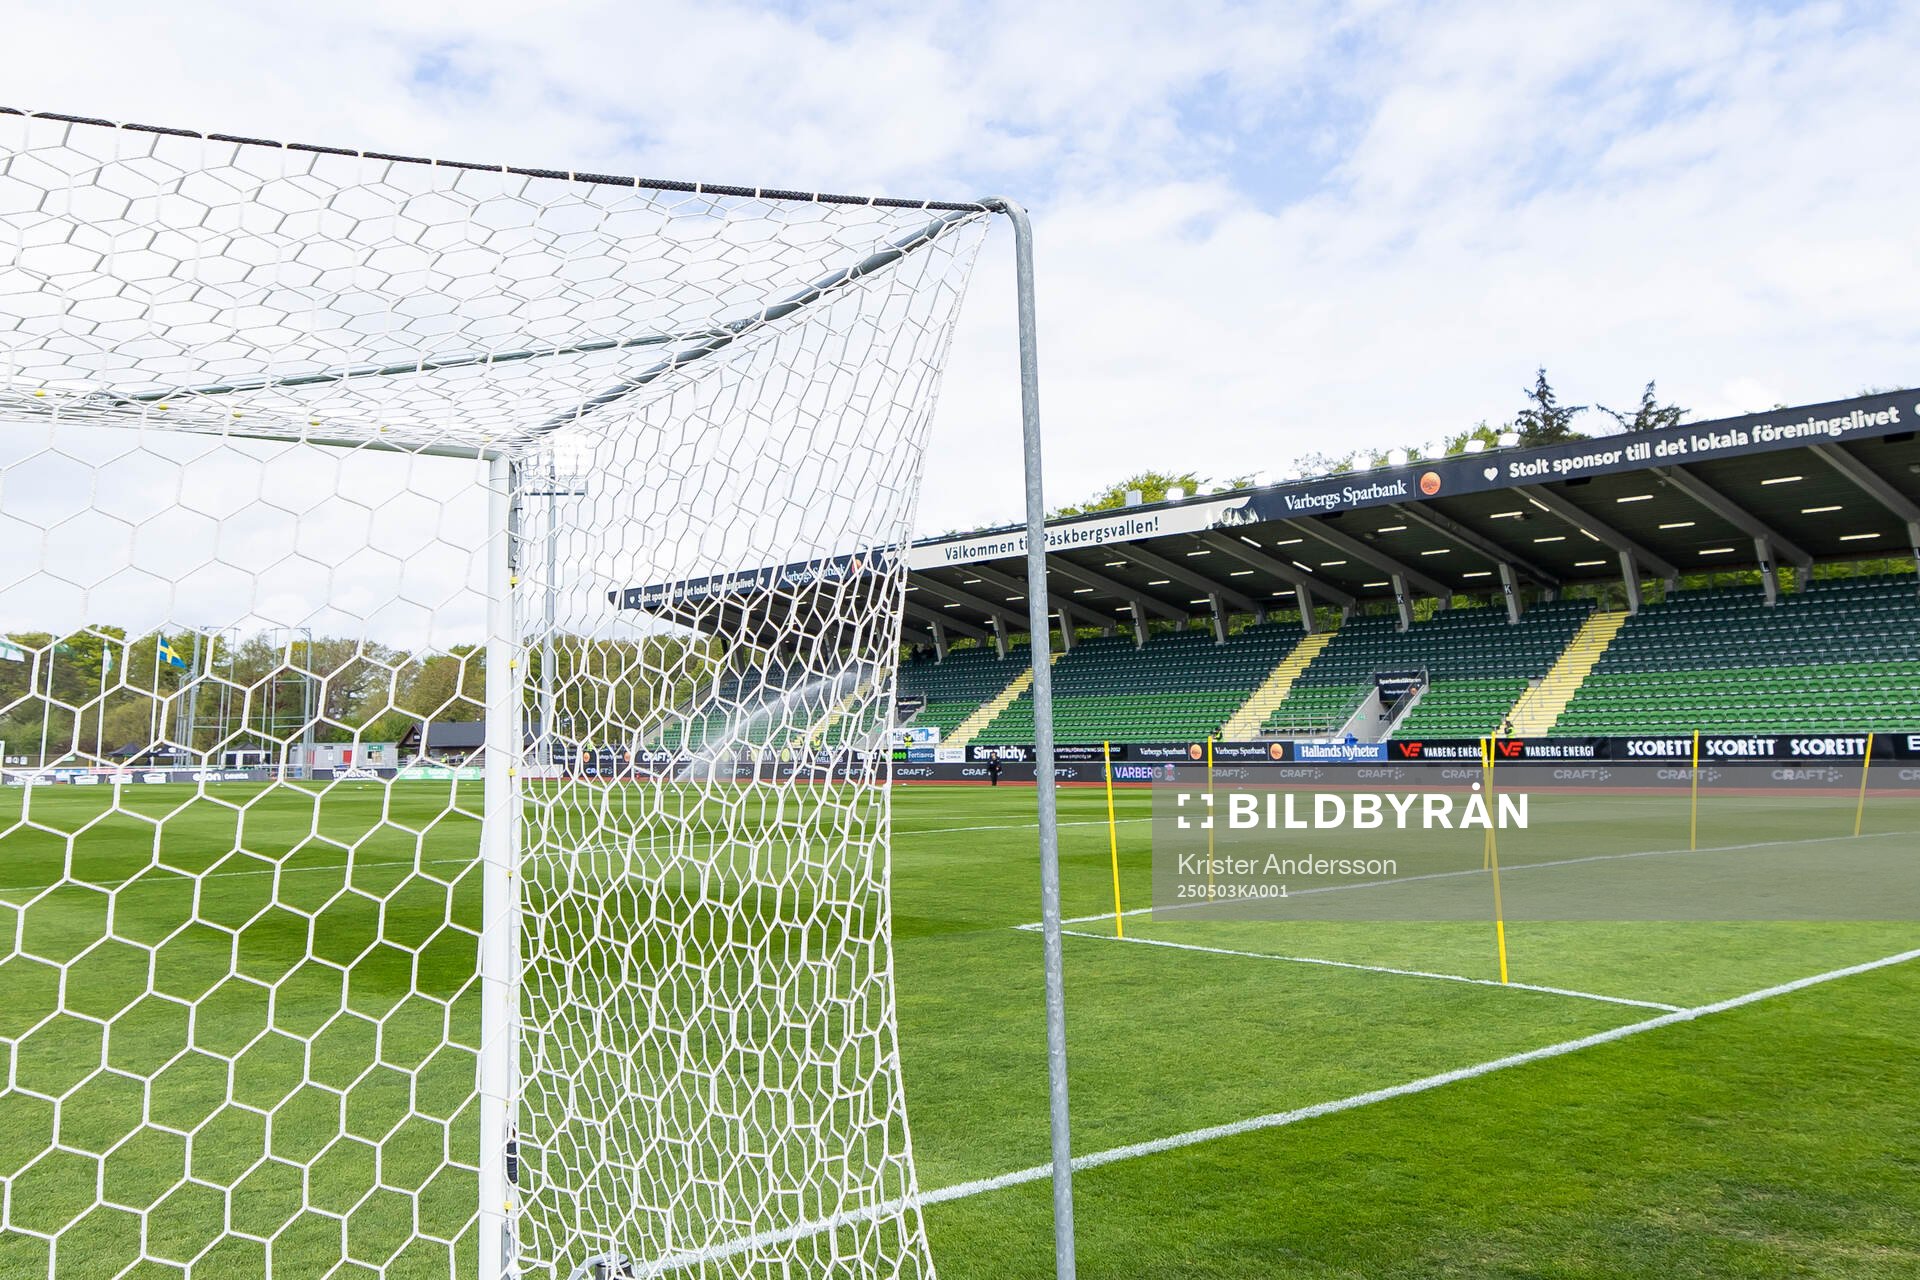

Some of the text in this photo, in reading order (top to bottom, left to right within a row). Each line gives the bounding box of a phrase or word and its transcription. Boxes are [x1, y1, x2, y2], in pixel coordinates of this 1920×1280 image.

[1509, 406, 1900, 479] Stolt sponsor till det lokala föreningslivet
[1284, 479, 1407, 511] Varbergs Sparbank
[944, 541, 1014, 561] Välkommen
[1301, 745, 1379, 760] Hallands Nyheter
[1424, 747, 1484, 757] VARBERG ENERG
[1525, 746, 1594, 757] VARBERG ENERGI
[1627, 738, 1865, 756] SCORETT SCORETT SCORETT
[897, 768, 925, 776] CRAFT
[962, 768, 988, 776] CRAF
[1115, 766, 1162, 779] VARBERG
[1280, 769, 1313, 778] CRAFT
[1357, 769, 1394, 778] CRAFT
[1441, 769, 1482, 779] CRAFT
[1553, 769, 1598, 779] CRAFT
[1771, 769, 1826, 780] CRAFT
